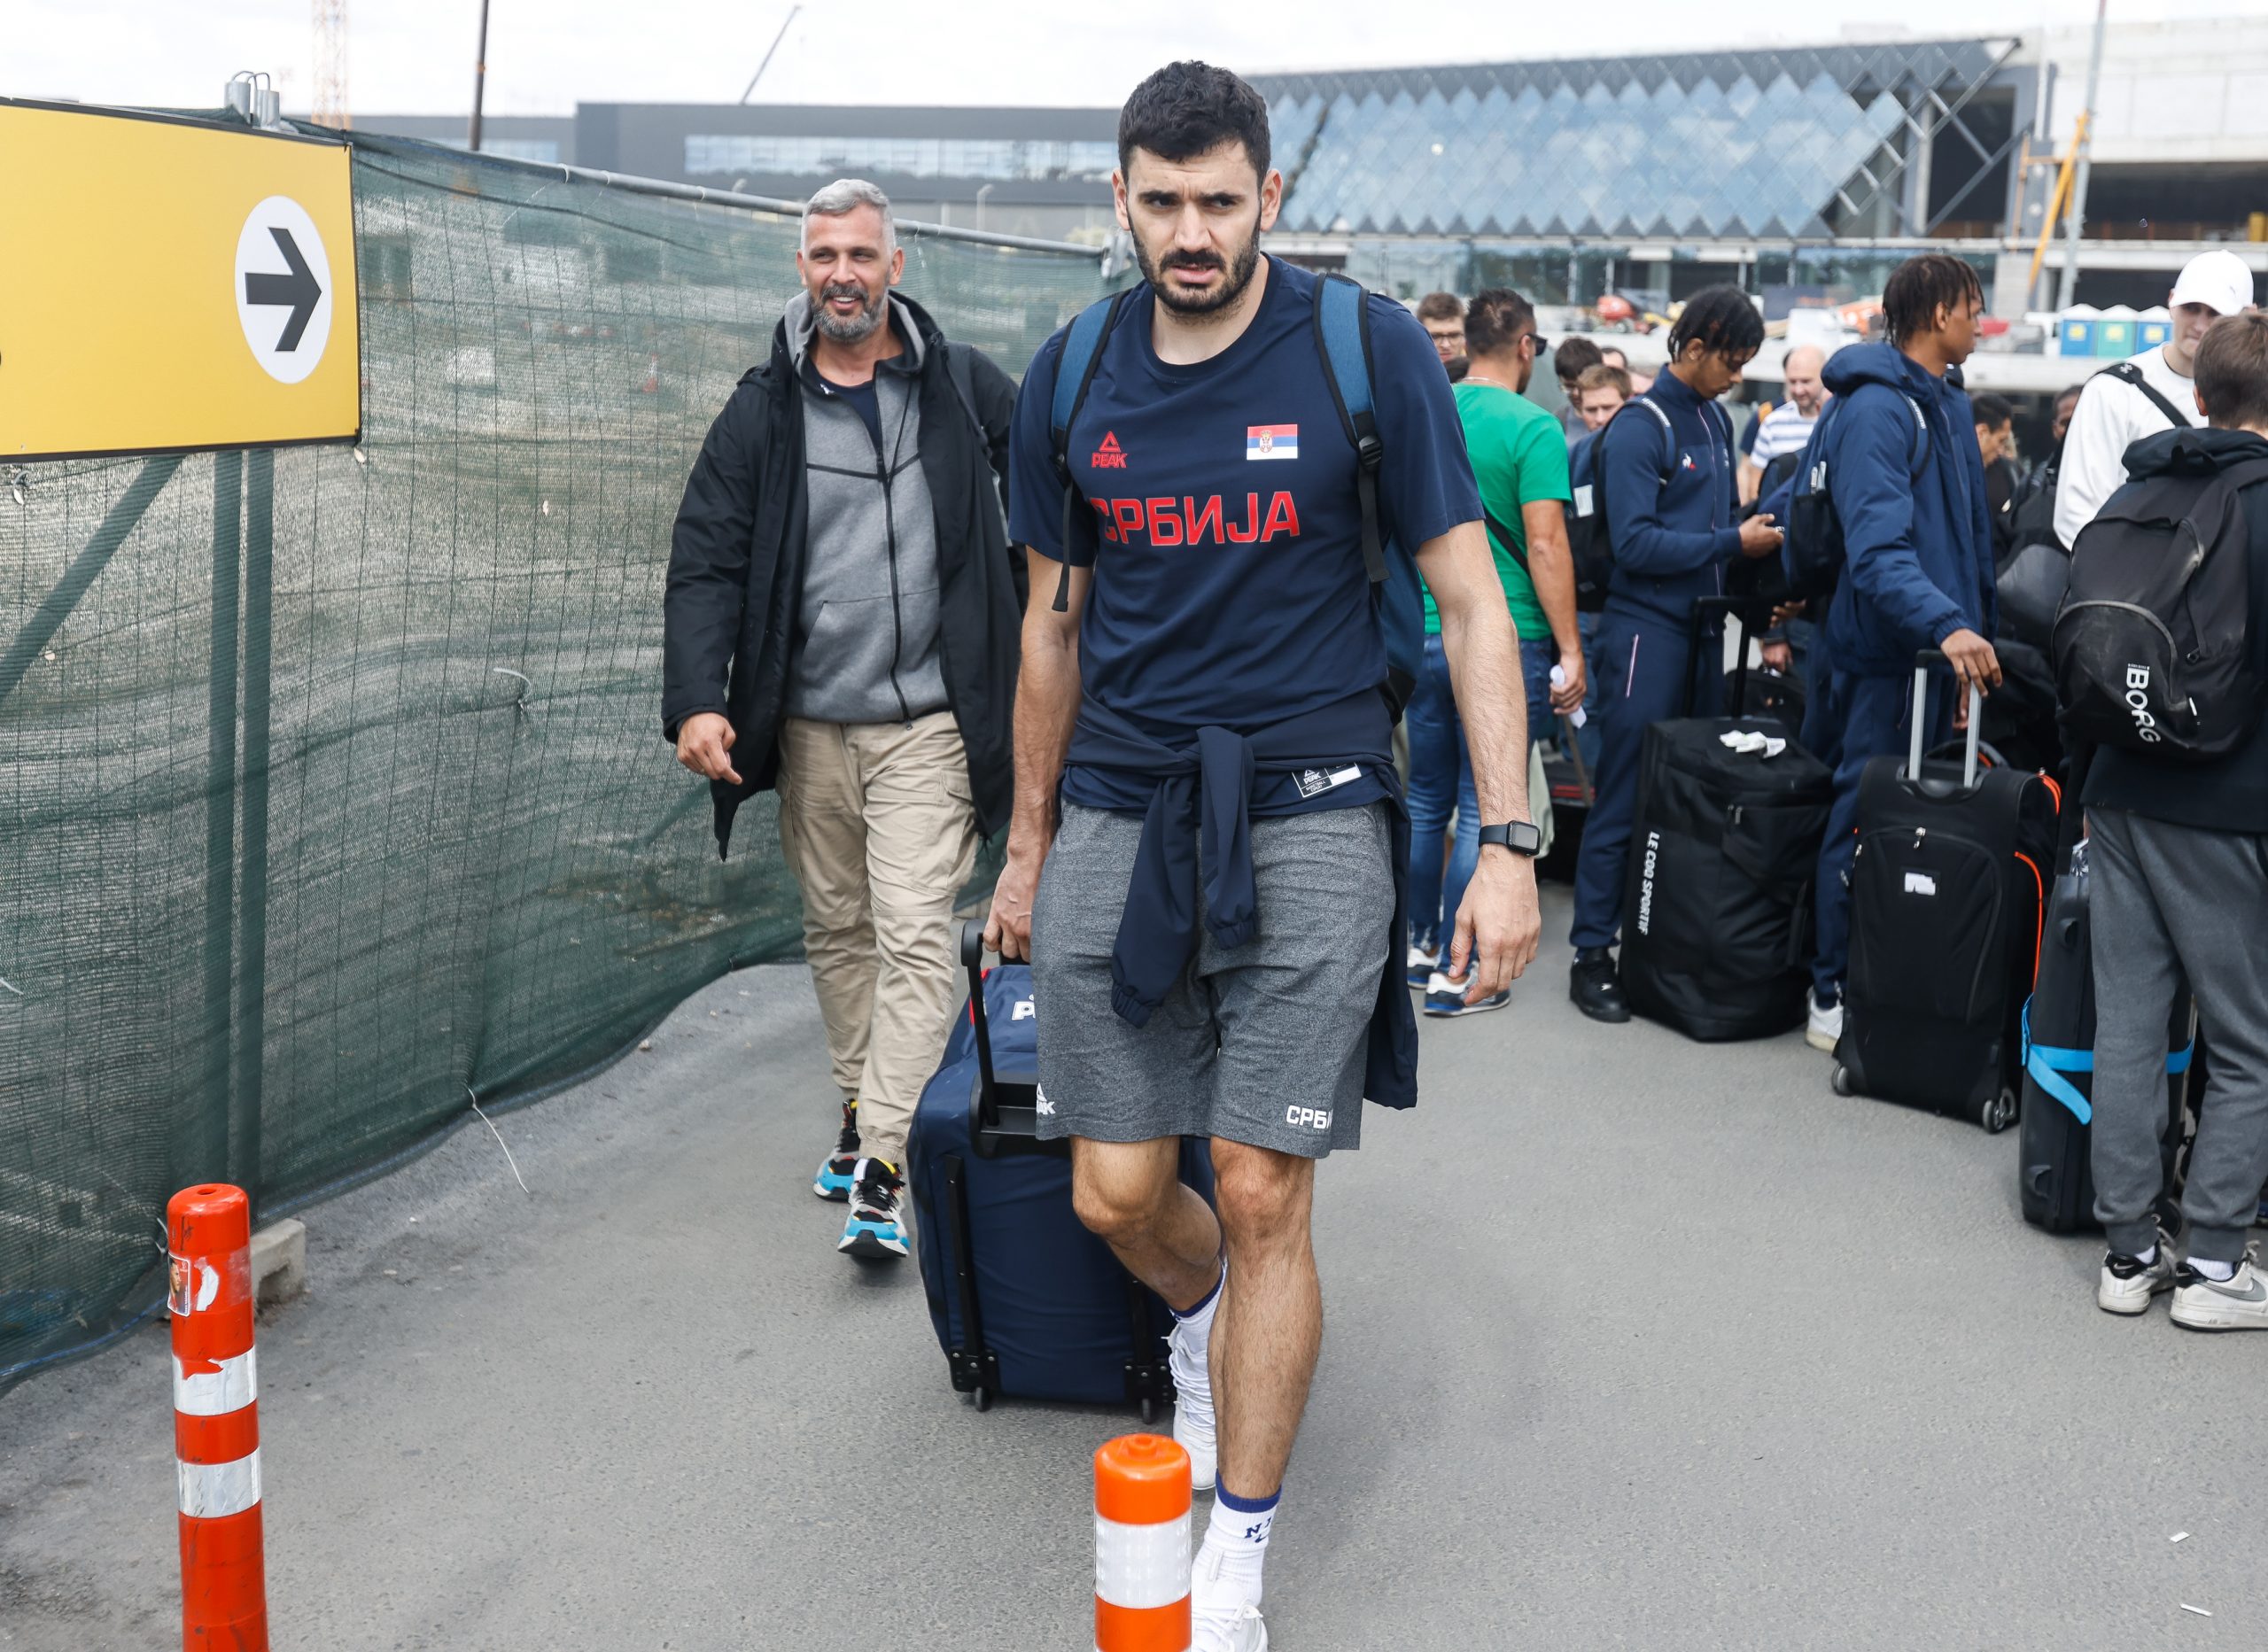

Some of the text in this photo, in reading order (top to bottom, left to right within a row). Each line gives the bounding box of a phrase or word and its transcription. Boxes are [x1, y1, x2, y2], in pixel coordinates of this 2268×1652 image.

[1091, 453, 1129, 468] PEAK
[1089, 491, 1301, 546] СРБИЈА
[2125, 667, 2162, 743] BORG
[1302, 772, 1322, 785] PEAK
[1637, 831, 1660, 935] LE COQ SPORTIF
